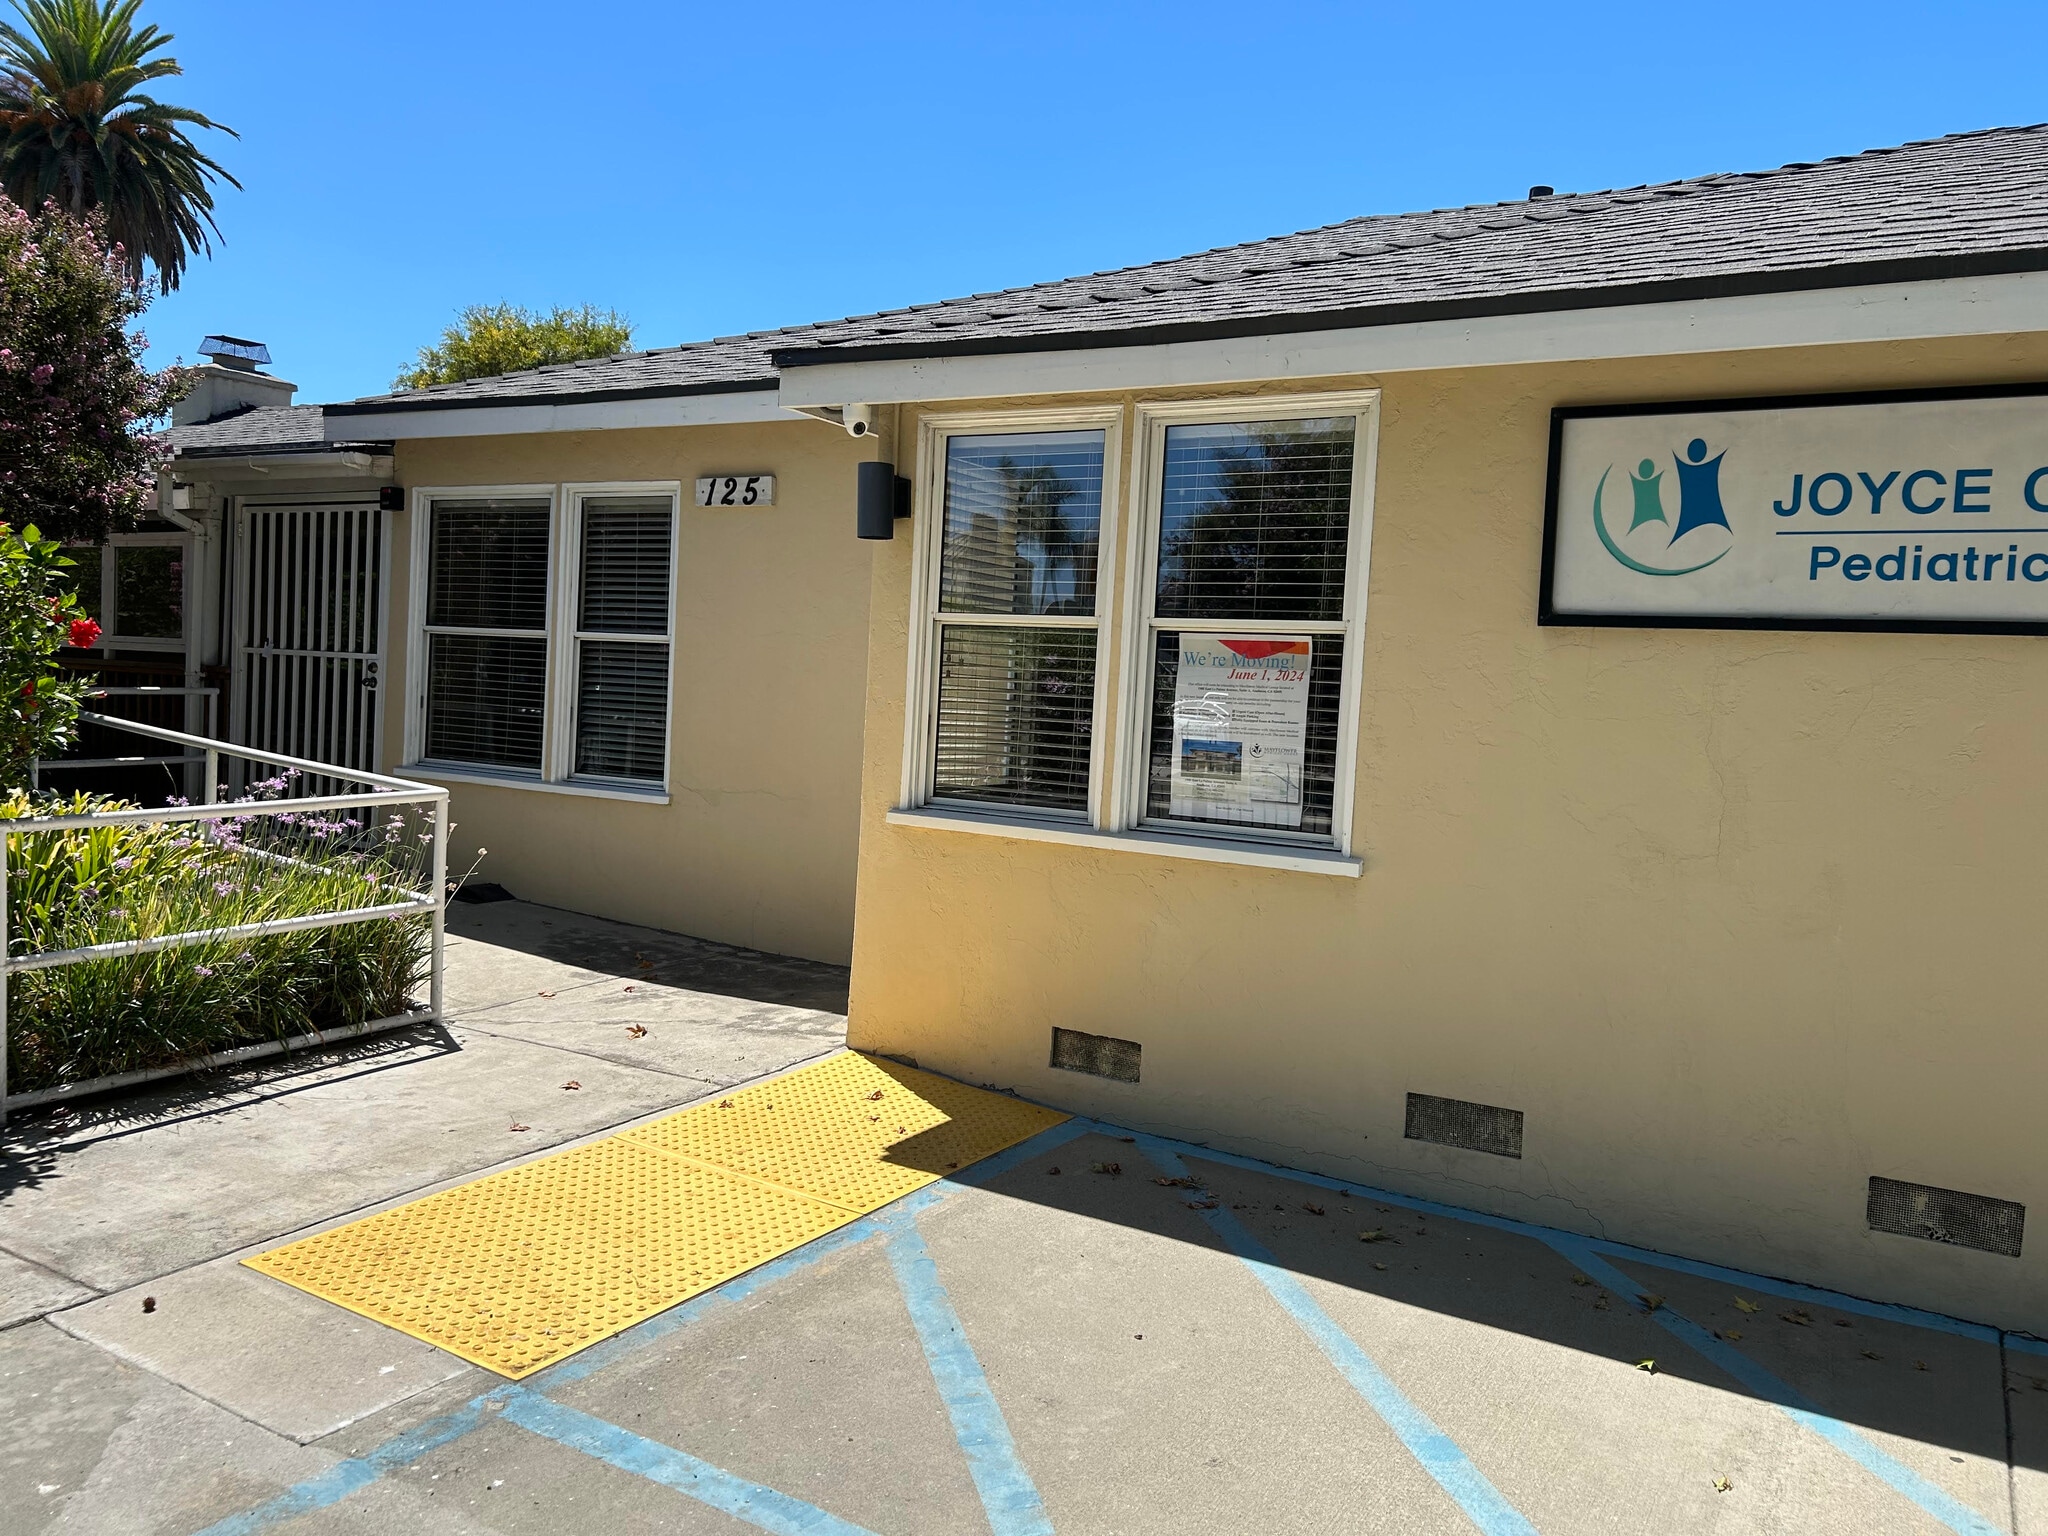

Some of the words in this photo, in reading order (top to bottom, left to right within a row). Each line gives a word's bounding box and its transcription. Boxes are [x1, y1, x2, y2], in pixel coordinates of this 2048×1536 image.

[704, 477, 760, 506] 125
[1773, 468, 1993, 517] JOYCE
[1809, 544, 2048, 583] Pediatric
[1184, 651, 1226, 666] We're
[1231, 652, 1295, 671] Moving!
[1227, 668, 1257, 680] June
[1261, 669, 1271, 682] 1,
[1274, 669, 1305, 682] 2024
